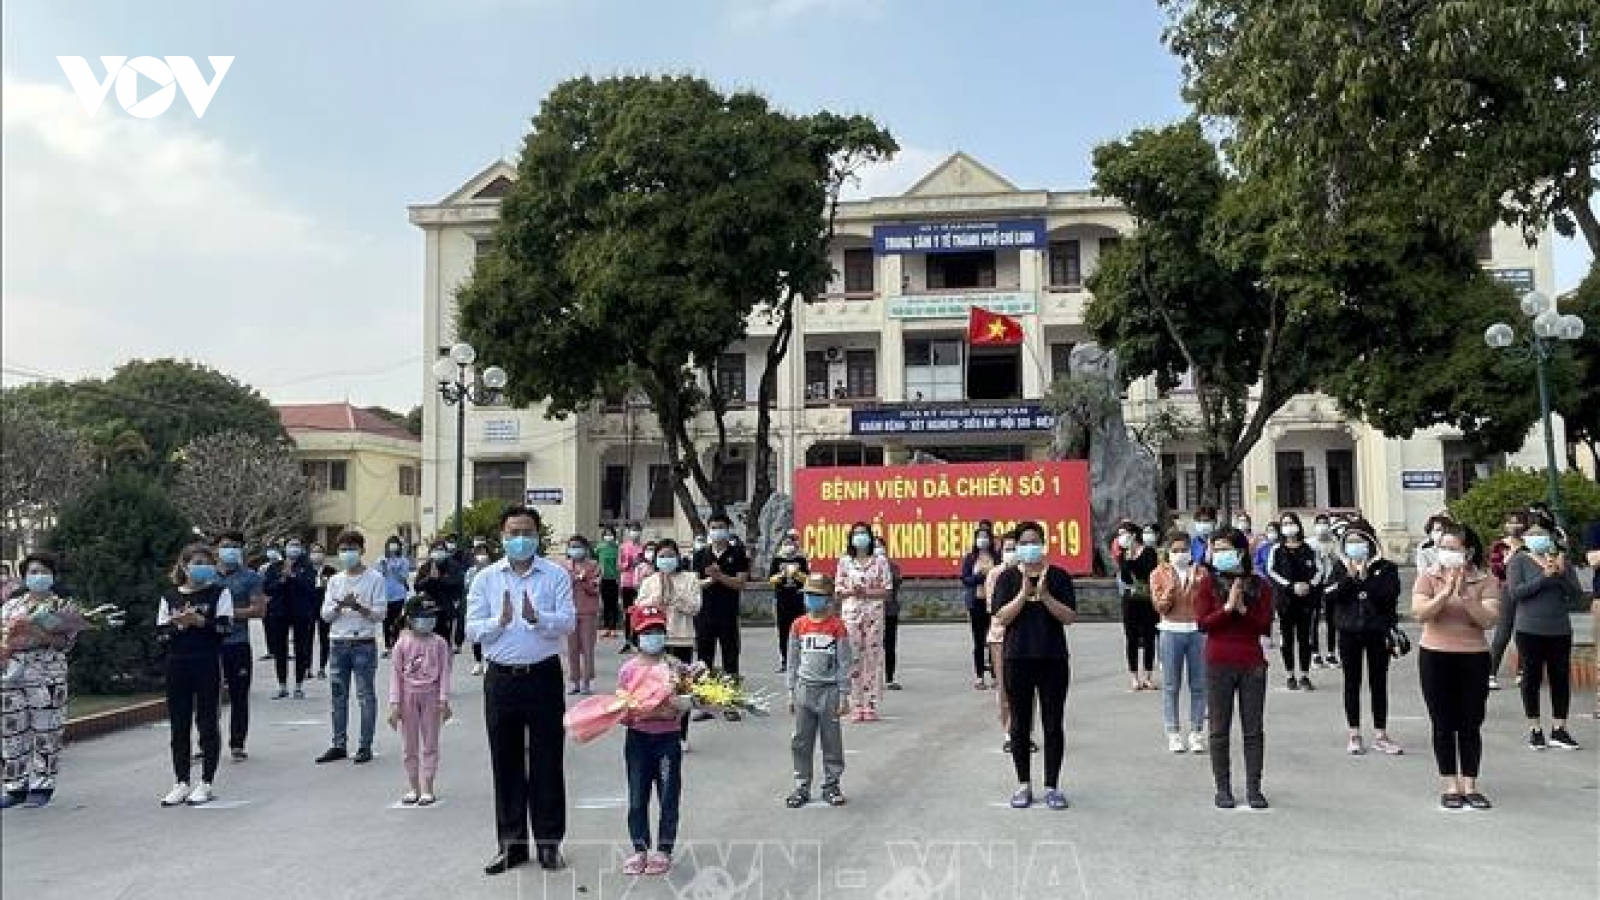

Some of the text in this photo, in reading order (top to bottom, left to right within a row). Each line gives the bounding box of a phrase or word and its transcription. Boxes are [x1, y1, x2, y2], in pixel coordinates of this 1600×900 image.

[822, 468, 1060, 505] BỆNH VIỆN DÃ CHIẾN SỐ 1
[888, 506, 932, 558] KHỎI
[937, 513, 980, 566] BỆN
